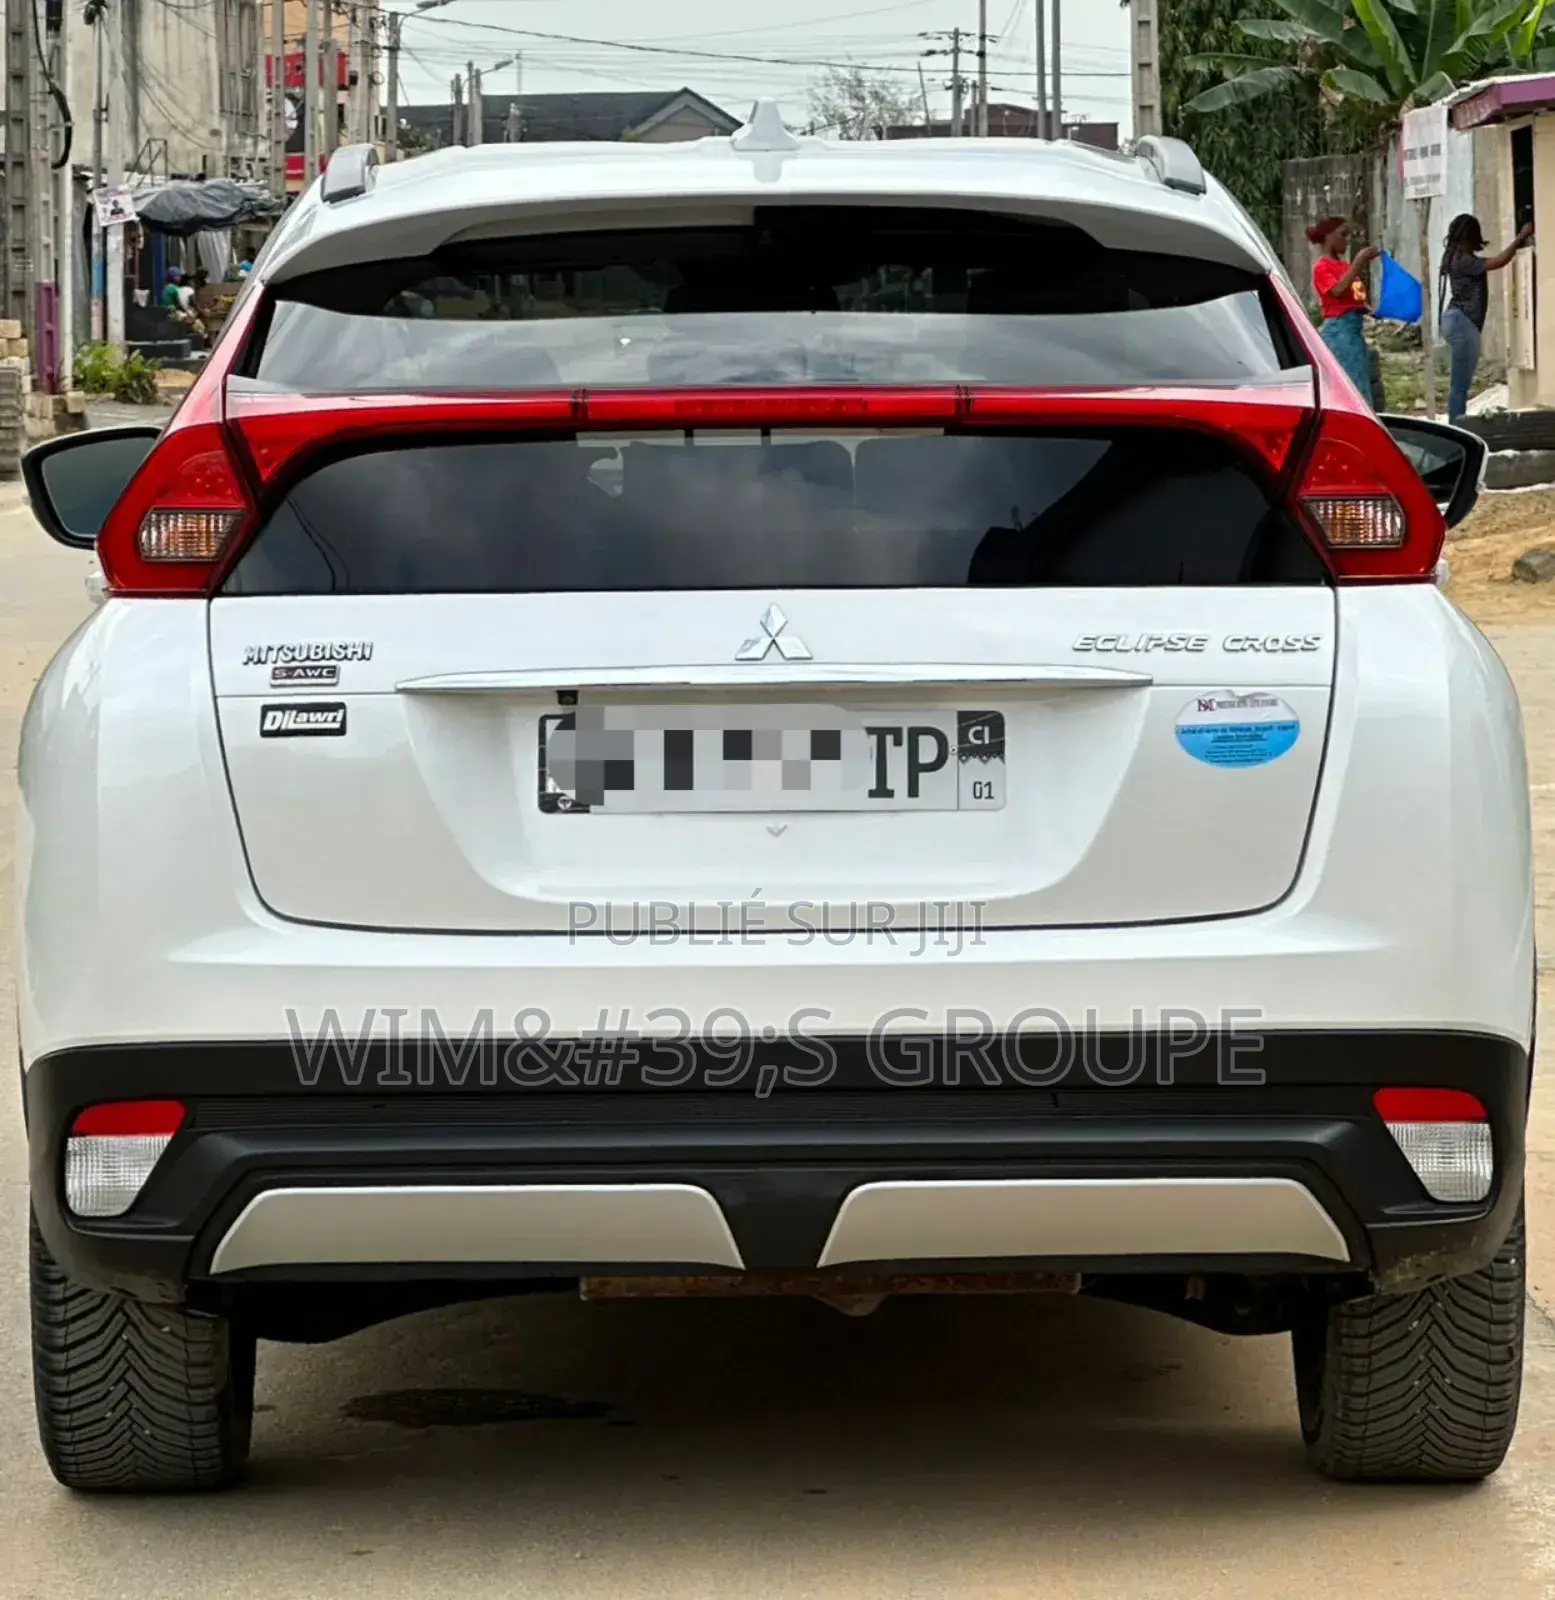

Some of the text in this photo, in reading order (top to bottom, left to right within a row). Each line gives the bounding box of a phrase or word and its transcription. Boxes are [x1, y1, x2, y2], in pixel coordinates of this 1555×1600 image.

[243, 640, 373, 665] MITSUBISHI
[1072, 633, 1322, 652] ECLIPSE CROSS
[273, 667, 335, 679] S-AWC
[967, 725, 991, 745] CI
[864, 726, 950, 799] TP
[972, 780, 995, 800] 01
